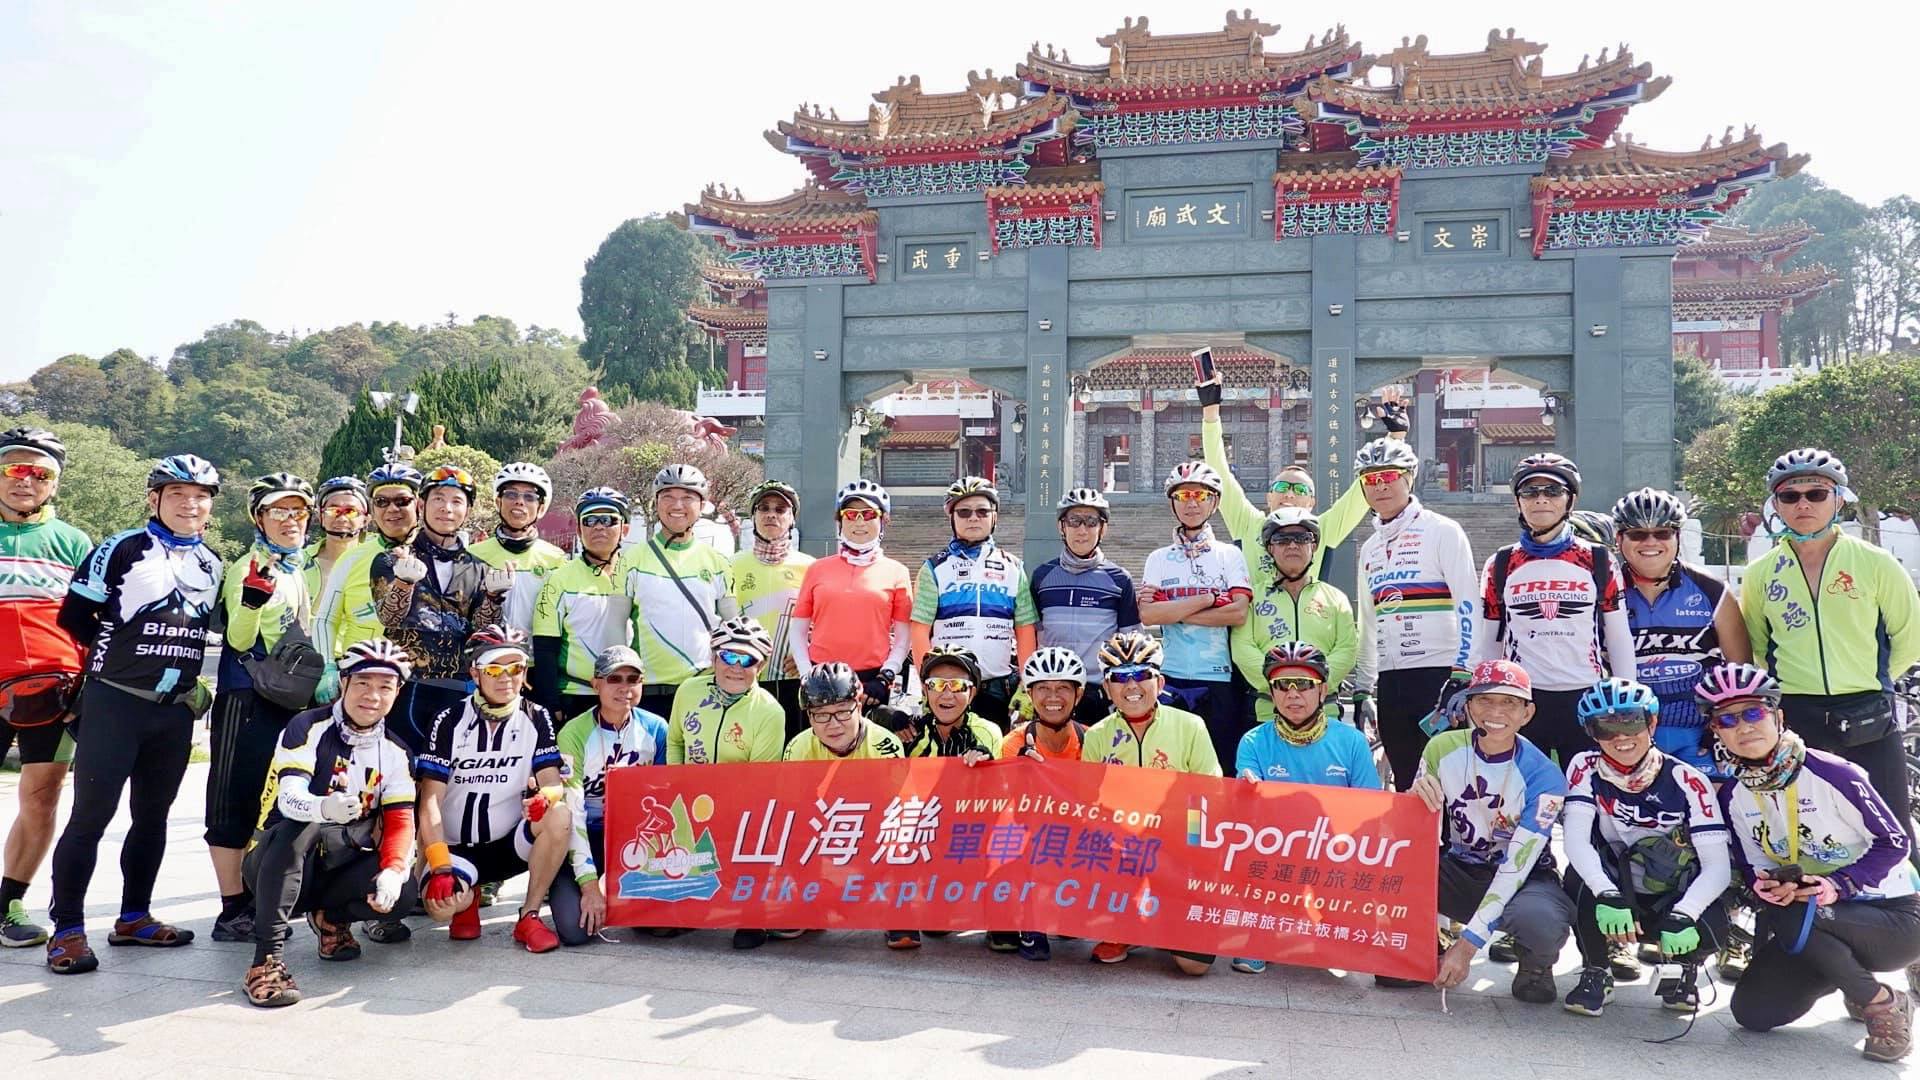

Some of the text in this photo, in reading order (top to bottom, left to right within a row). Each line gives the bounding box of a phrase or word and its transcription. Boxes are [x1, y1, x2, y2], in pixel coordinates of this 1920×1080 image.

[1510, 580, 1589, 595] TREK
[1512, 592, 1588, 602] WORLD RACING
[1455, 617, 1473, 667] GIAN
[1664, 664, 1696, 676] STEP
[459, 755, 524, 771] GIANT
[955, 794, 1162, 828] www.bikexc.com
[731, 794, 942, 867] 山海戀
[944, 821, 1162, 877] 單車俱樂部
[731, 874, 1161, 918] Bike Explorer Club
[1248, 860, 1404, 896] 愛運動旅遊網
[1187, 878, 1409, 919] www.isportour.com
[1186, 904, 1409, 951] 晨光國際旅行社板橋分公司
